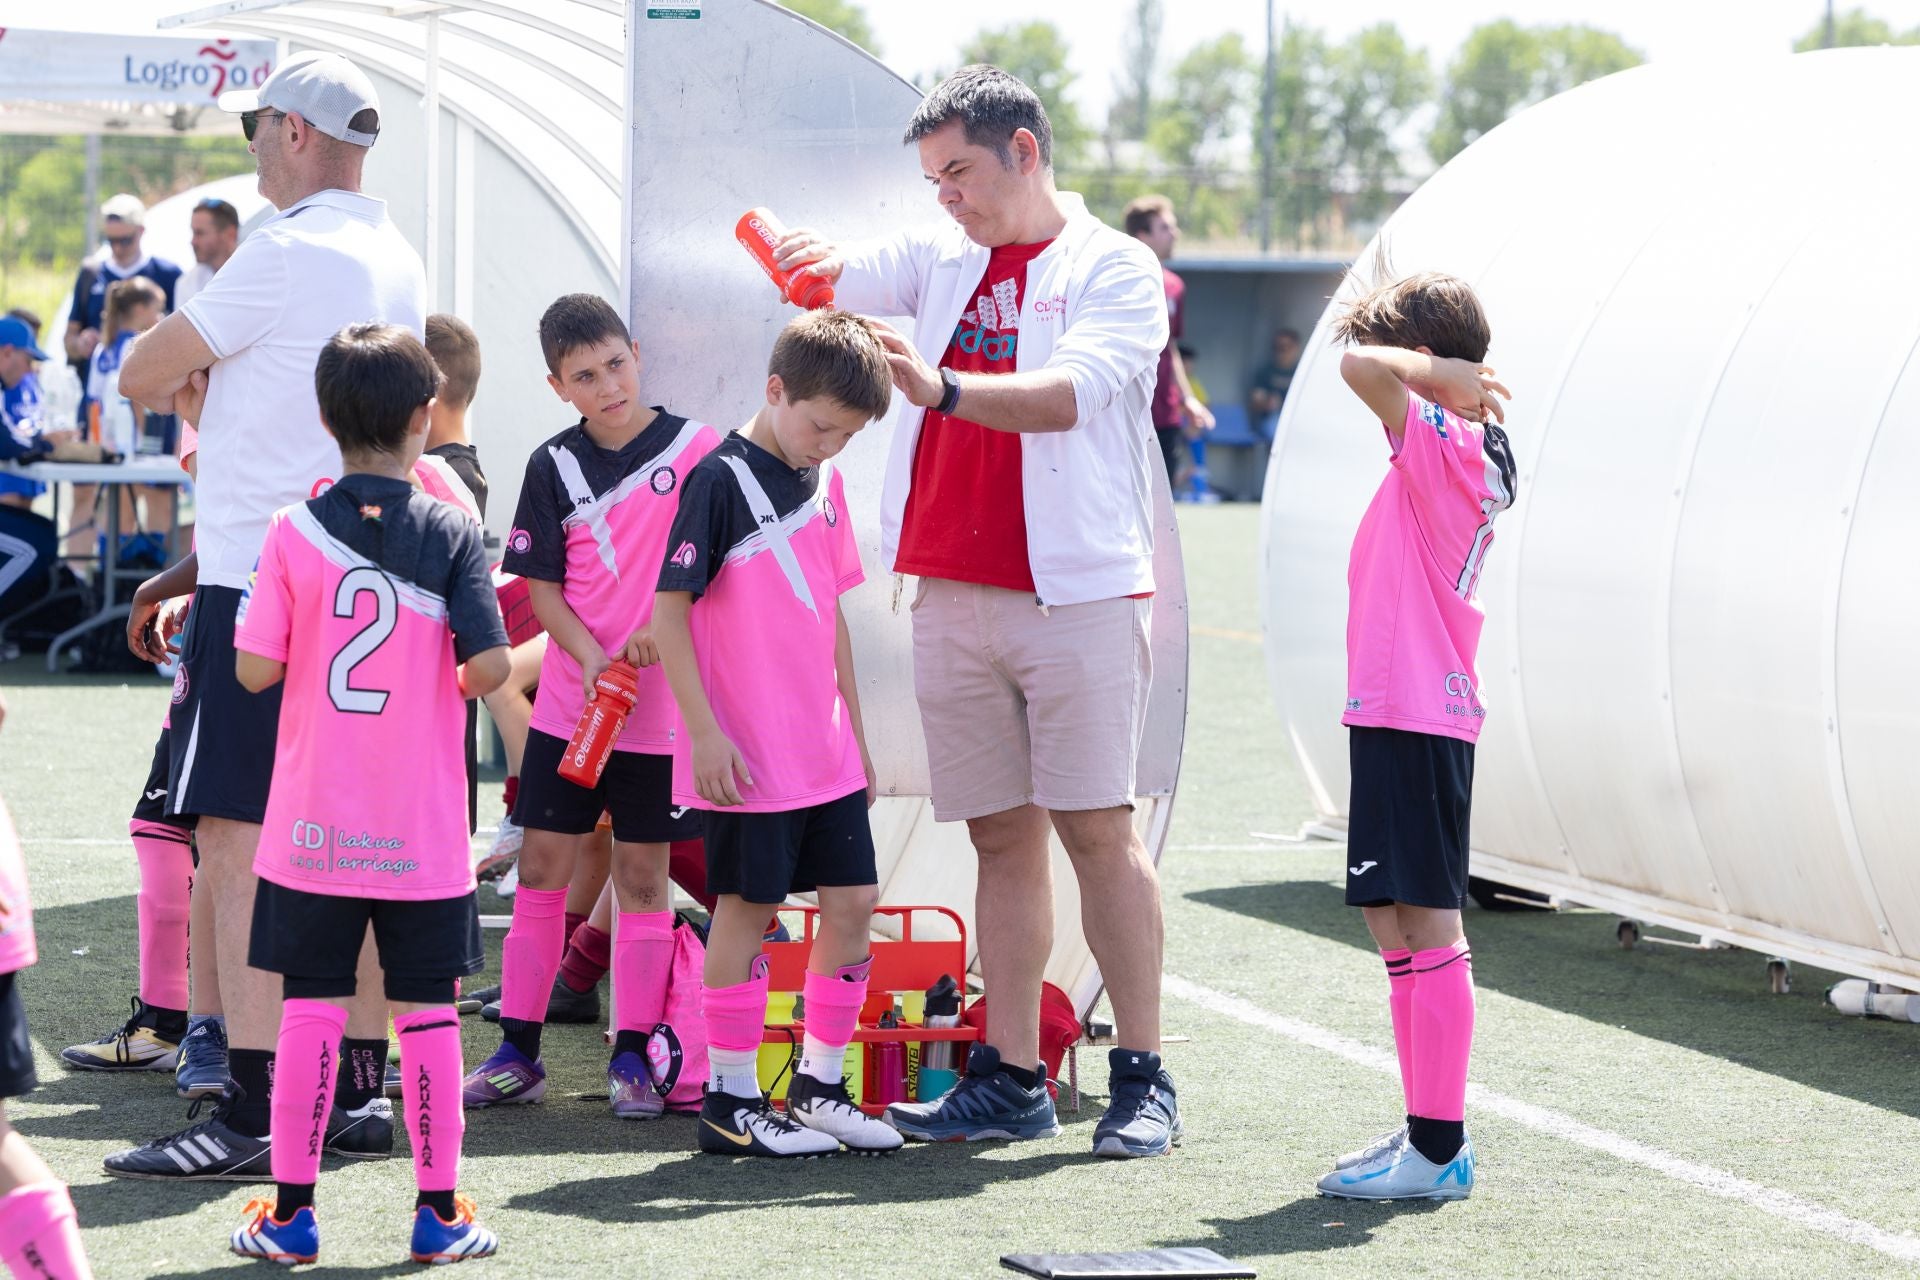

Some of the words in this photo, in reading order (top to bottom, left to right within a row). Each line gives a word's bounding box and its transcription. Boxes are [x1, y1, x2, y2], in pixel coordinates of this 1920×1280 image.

[327, 566, 399, 715] 2
[1445, 671, 1472, 698] CD
[582, 706, 605, 754] ENERVIT
[291, 818, 326, 850] CD
[337, 830, 406, 850] lakua
[289, 854, 325, 872] 1984
[337, 853, 420, 877] arriaga
[318, 1041, 331, 1090] LAKUA
[418, 1064, 431, 1111] LAKUA
[308, 1093, 326, 1157] ARRIAGA
[420, 1113, 433, 1169] ARRIAGA
